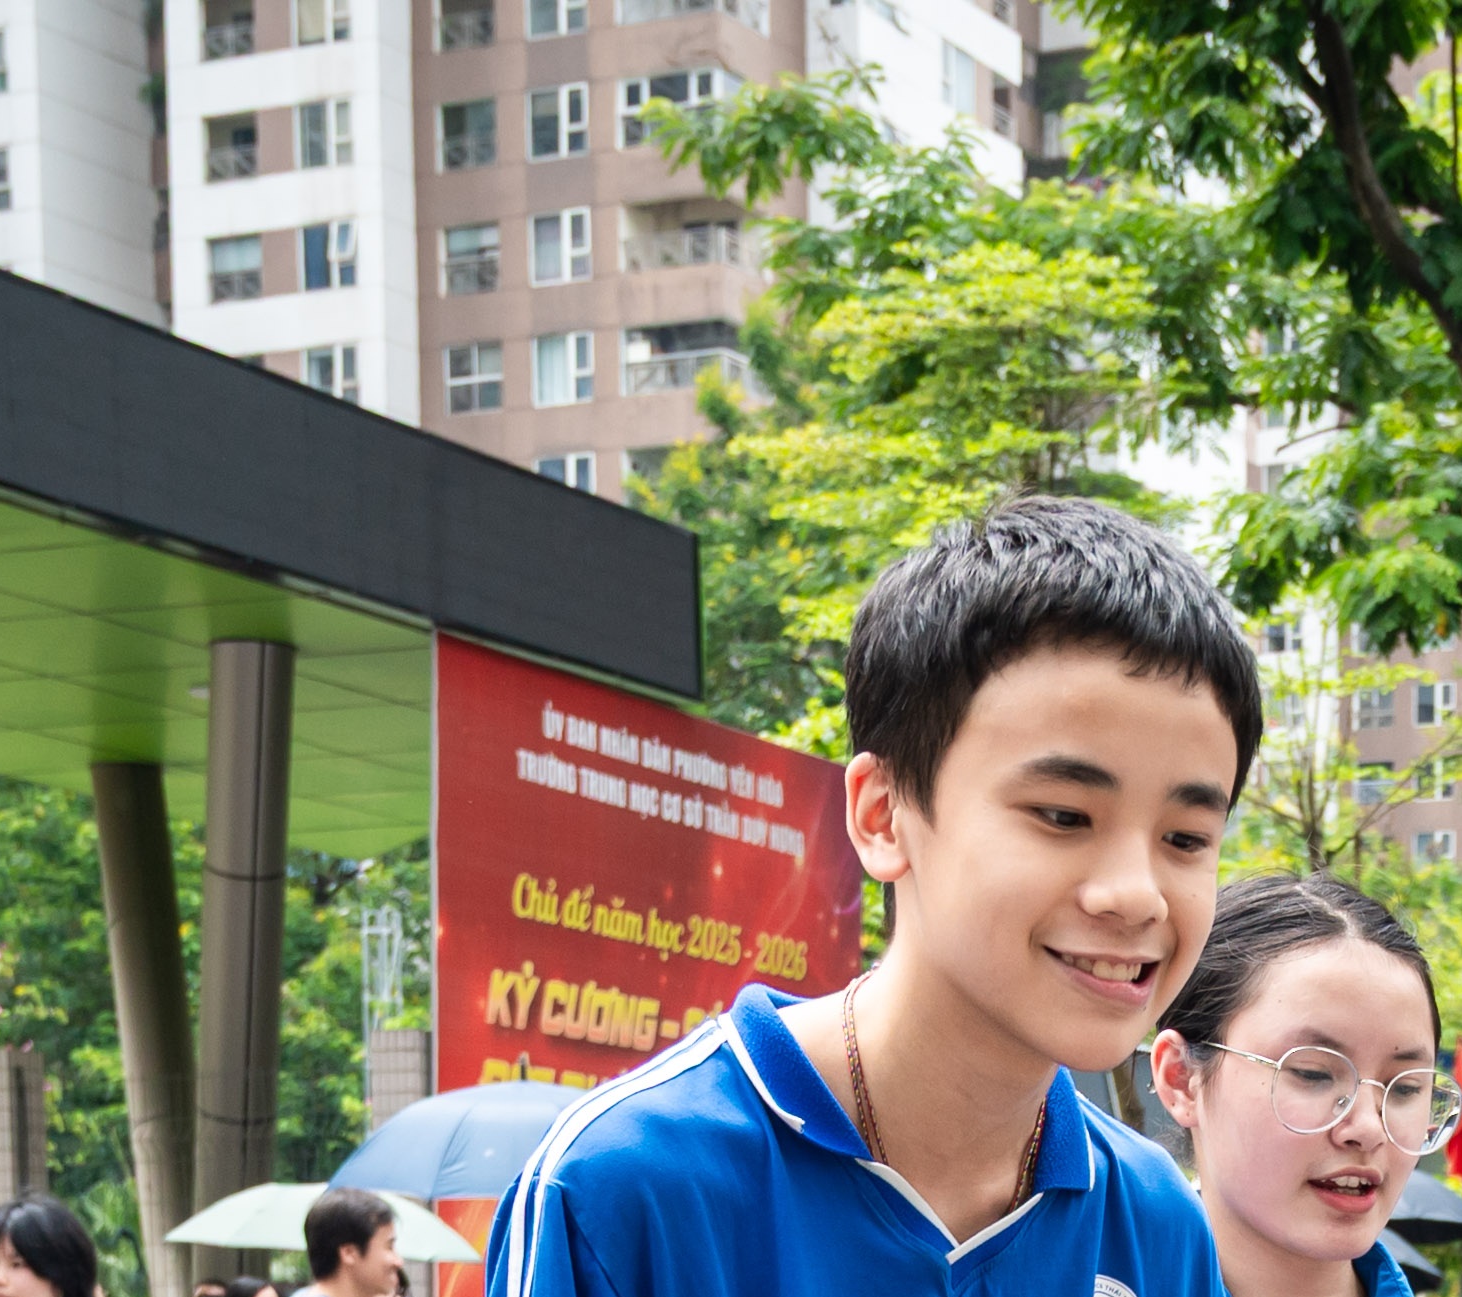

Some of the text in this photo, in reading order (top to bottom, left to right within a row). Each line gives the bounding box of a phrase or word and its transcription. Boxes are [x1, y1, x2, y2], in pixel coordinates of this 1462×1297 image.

[516, 747, 578, 795] TRƯỜNG
[579, 766, 627, 809] TRUNG
[629, 782, 659, 820] HỌC
[660, 790, 682, 824] CƠ
[741, 814, 768, 848] DUY
[566, 714, 597, 752] BAN
[599, 726, 639, 765] NHÂN
[640, 735, 671, 775] DÂN
[672, 748, 727, 791] PHƯỜNG
[729, 762, 755, 799] YÊN
[512, 872, 560, 925] Chủ
[561, 884, 595, 932] đề
[593, 896, 645, 945] năm
[646, 907, 686, 962] học
[687, 914, 742, 966] 2025
[754, 931, 809, 981] 2026
[484, 960, 541, 1031] KỶ
[539, 979, 662, 1052] CƯƠNG
